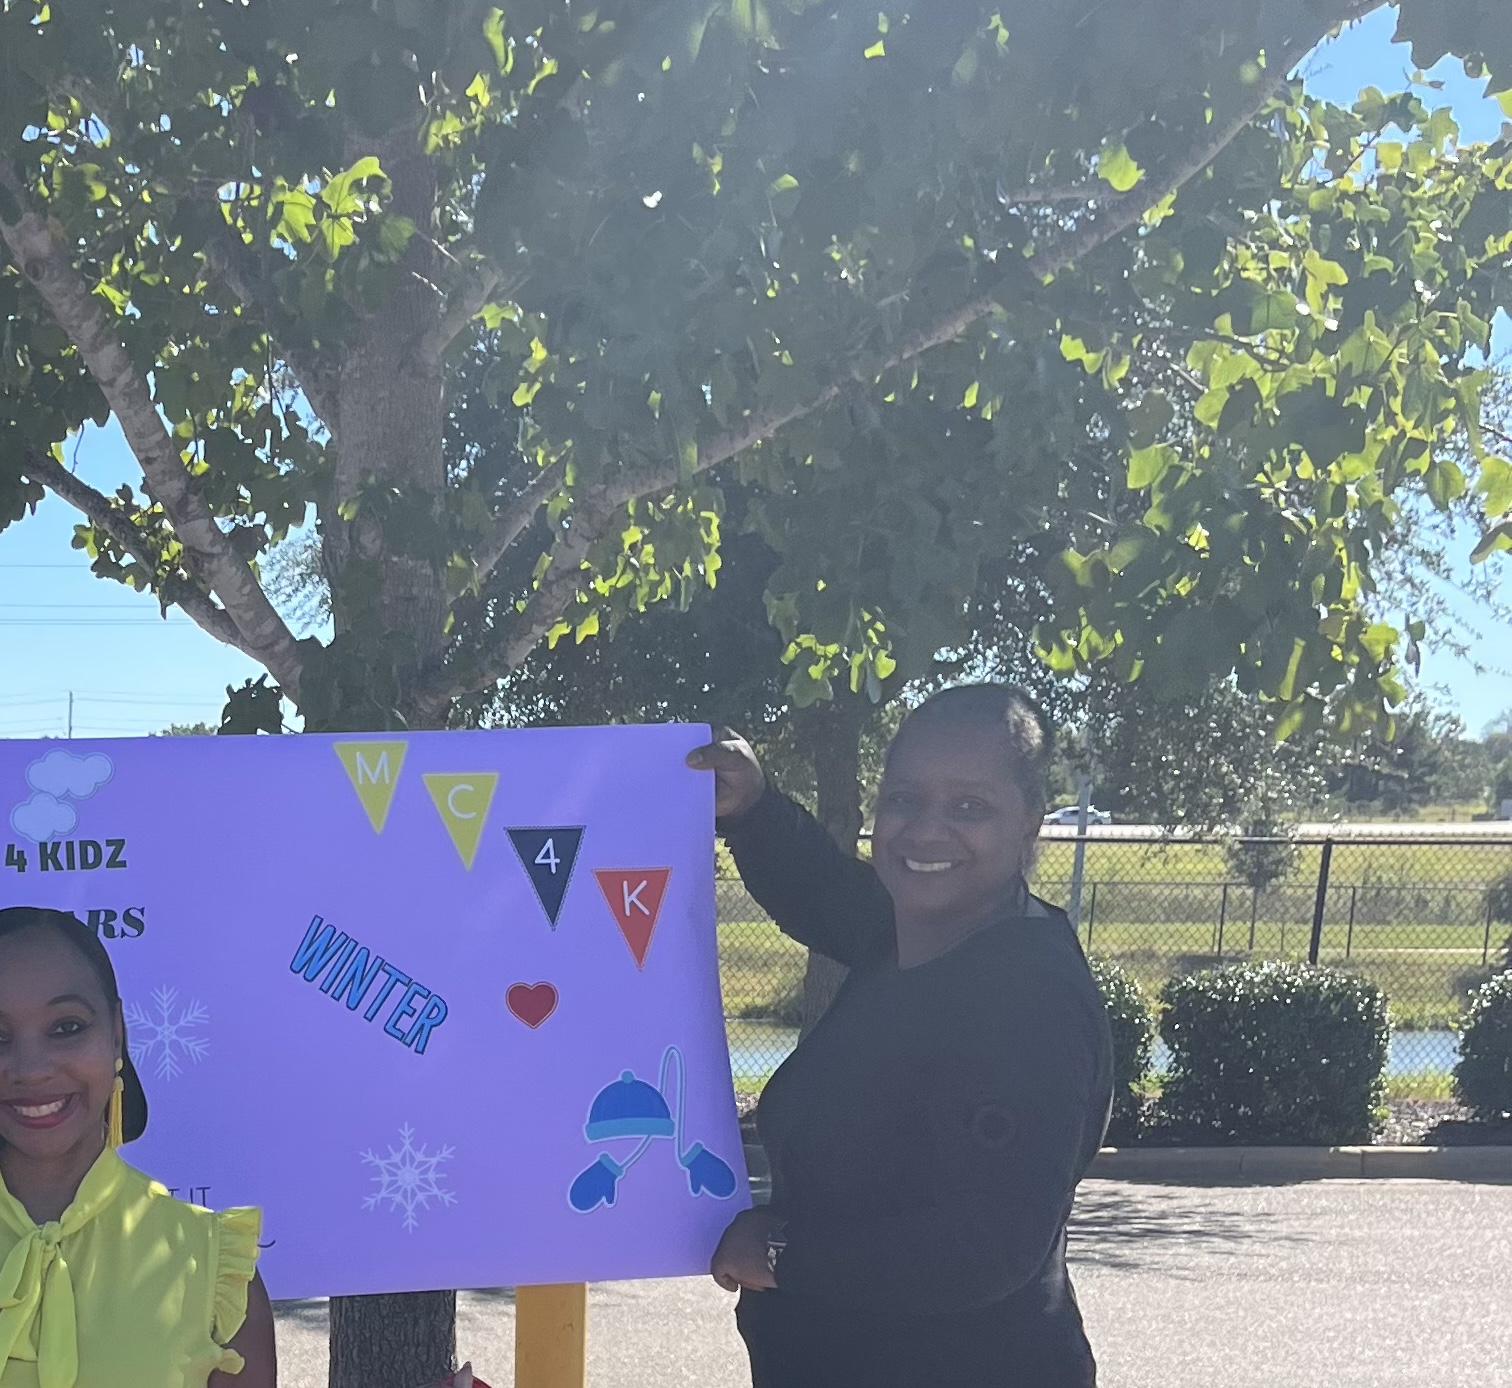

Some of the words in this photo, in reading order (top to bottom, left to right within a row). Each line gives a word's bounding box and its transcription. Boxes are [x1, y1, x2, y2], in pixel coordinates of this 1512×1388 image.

[5, 843, 28, 873] 4
[40, 838, 127, 872] KIDZ
[356, 751, 390, 785] M
[447, 784, 477, 819] C
[534, 838, 561, 874] 4
[622, 879, 650, 917] K
[289, 914, 449, 1056] WINTER
